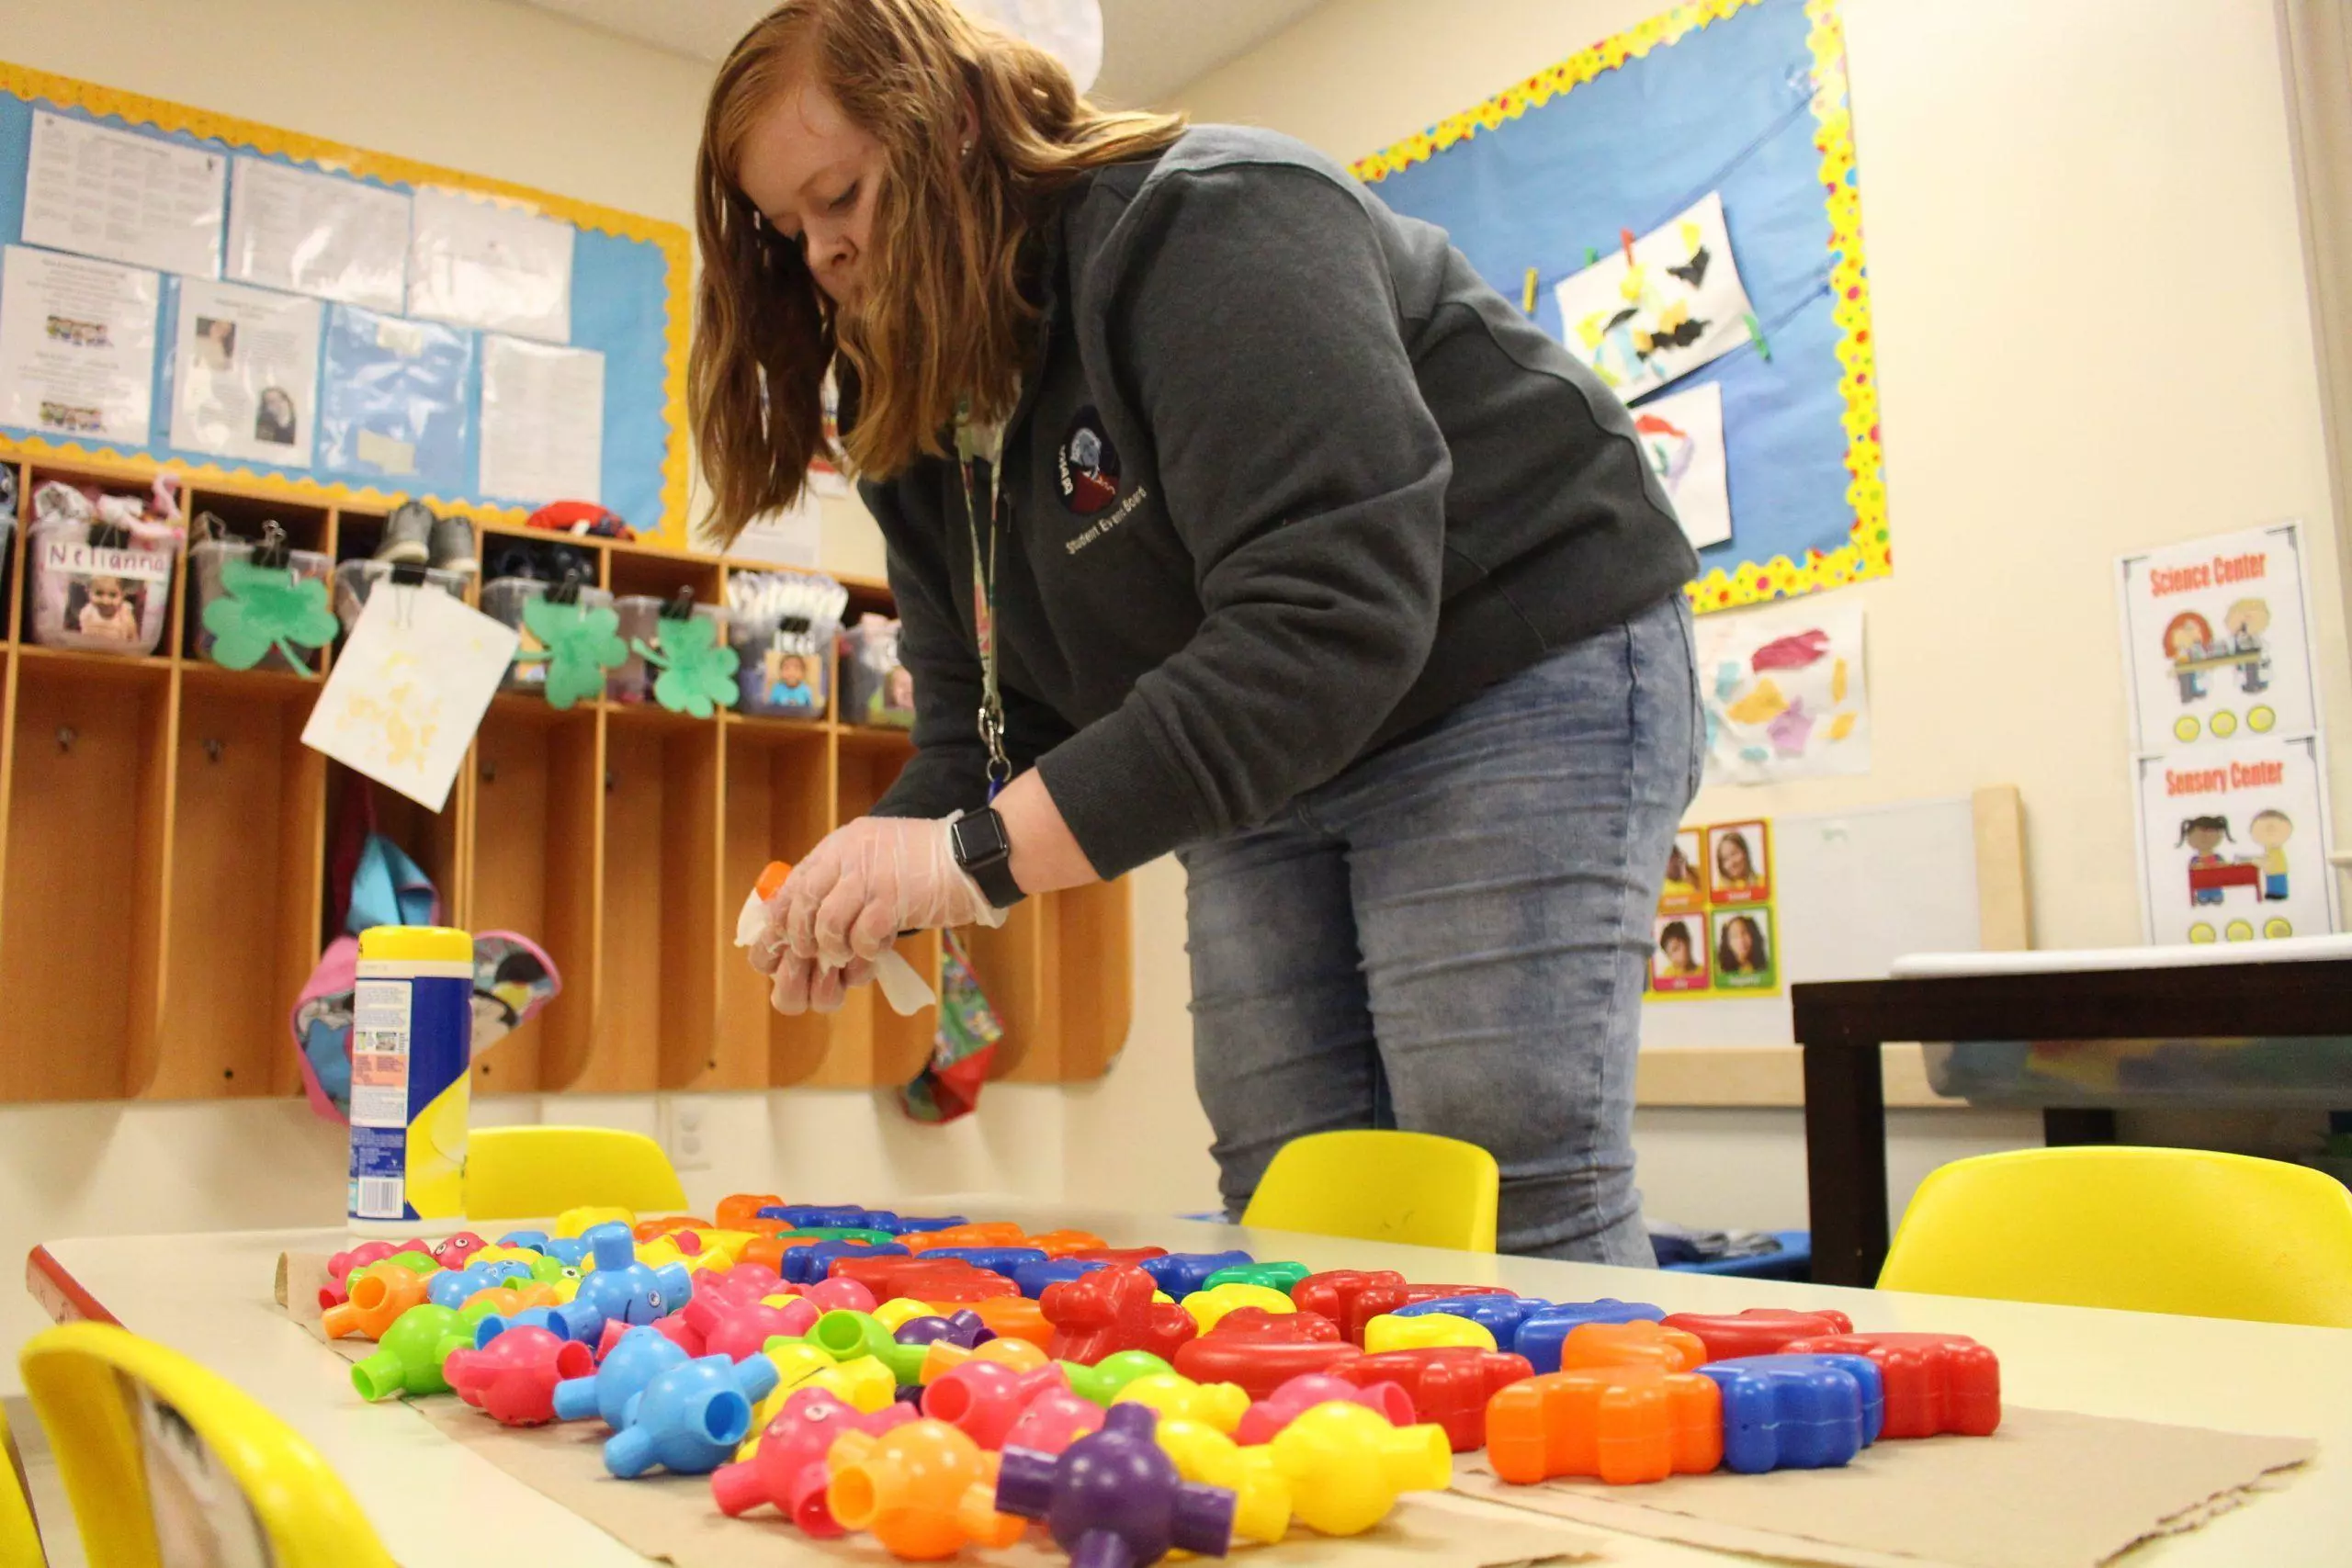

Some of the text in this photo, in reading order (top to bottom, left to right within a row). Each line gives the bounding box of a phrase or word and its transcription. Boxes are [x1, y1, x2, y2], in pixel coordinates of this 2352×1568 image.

[1066, 525, 1101, 555] Student
[1099, 507, 1127, 532] Event
[2152, 554, 2266, 596] Science Center
[2165, 761, 2283, 795] Sensory Center
